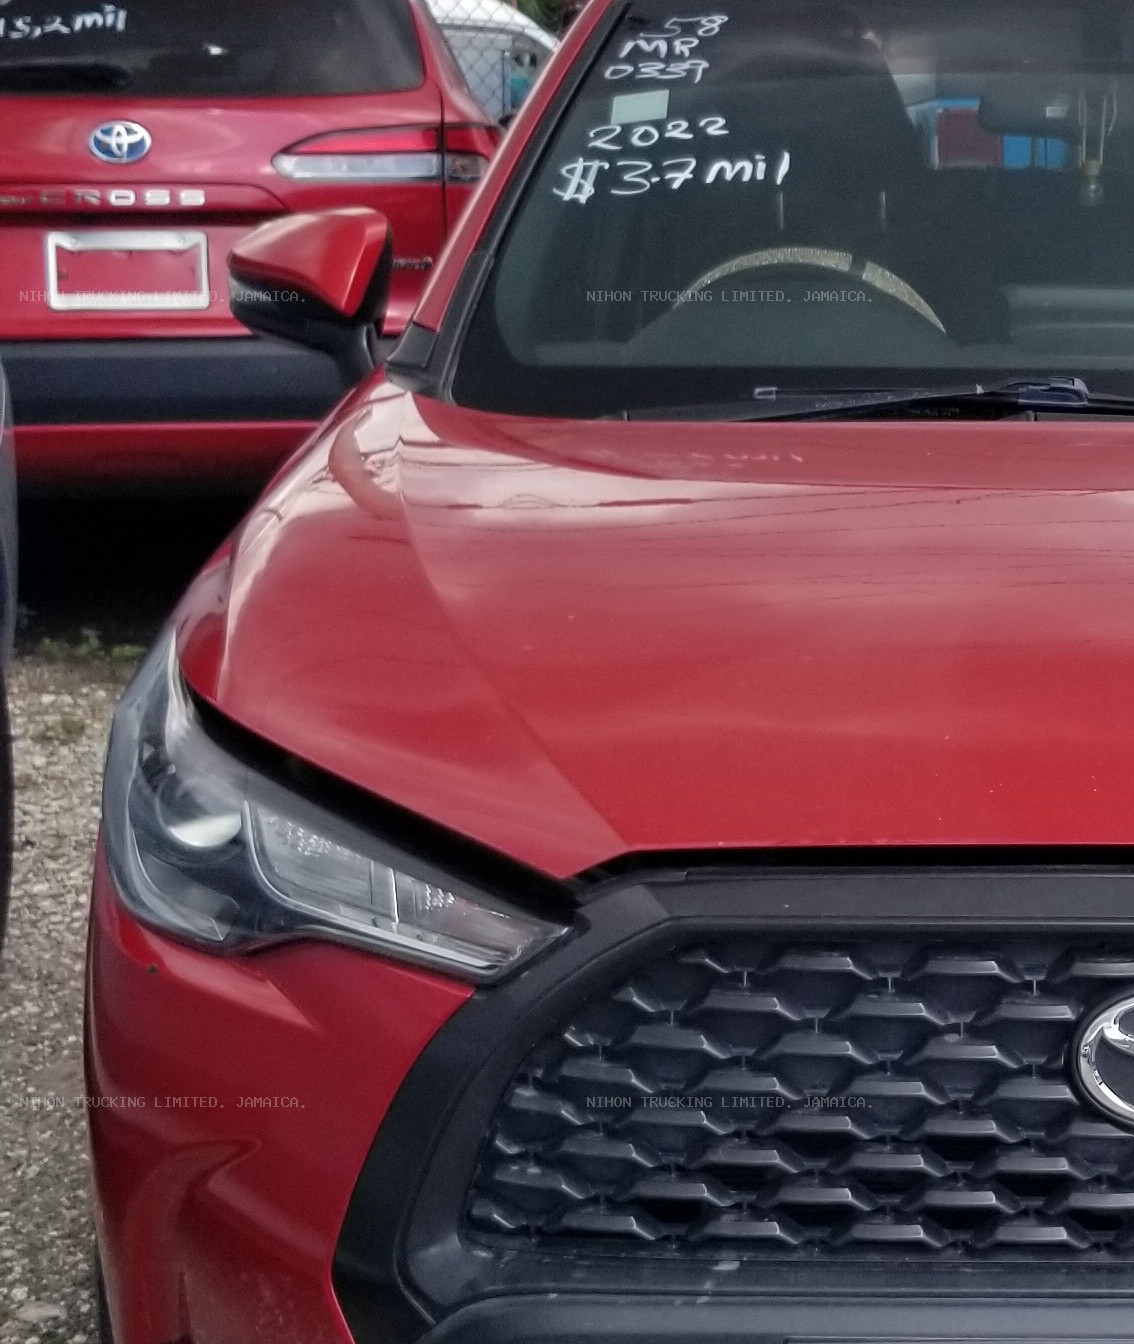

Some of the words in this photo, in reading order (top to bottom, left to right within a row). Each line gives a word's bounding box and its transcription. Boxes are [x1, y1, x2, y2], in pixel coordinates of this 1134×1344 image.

[639, 14, 729, 38] 58
[618, 37, 699, 58] MR
[603, 58, 710, 84] 0339
[587, 116, 730, 150] 2022
[552, 156, 697, 205] $3.7
